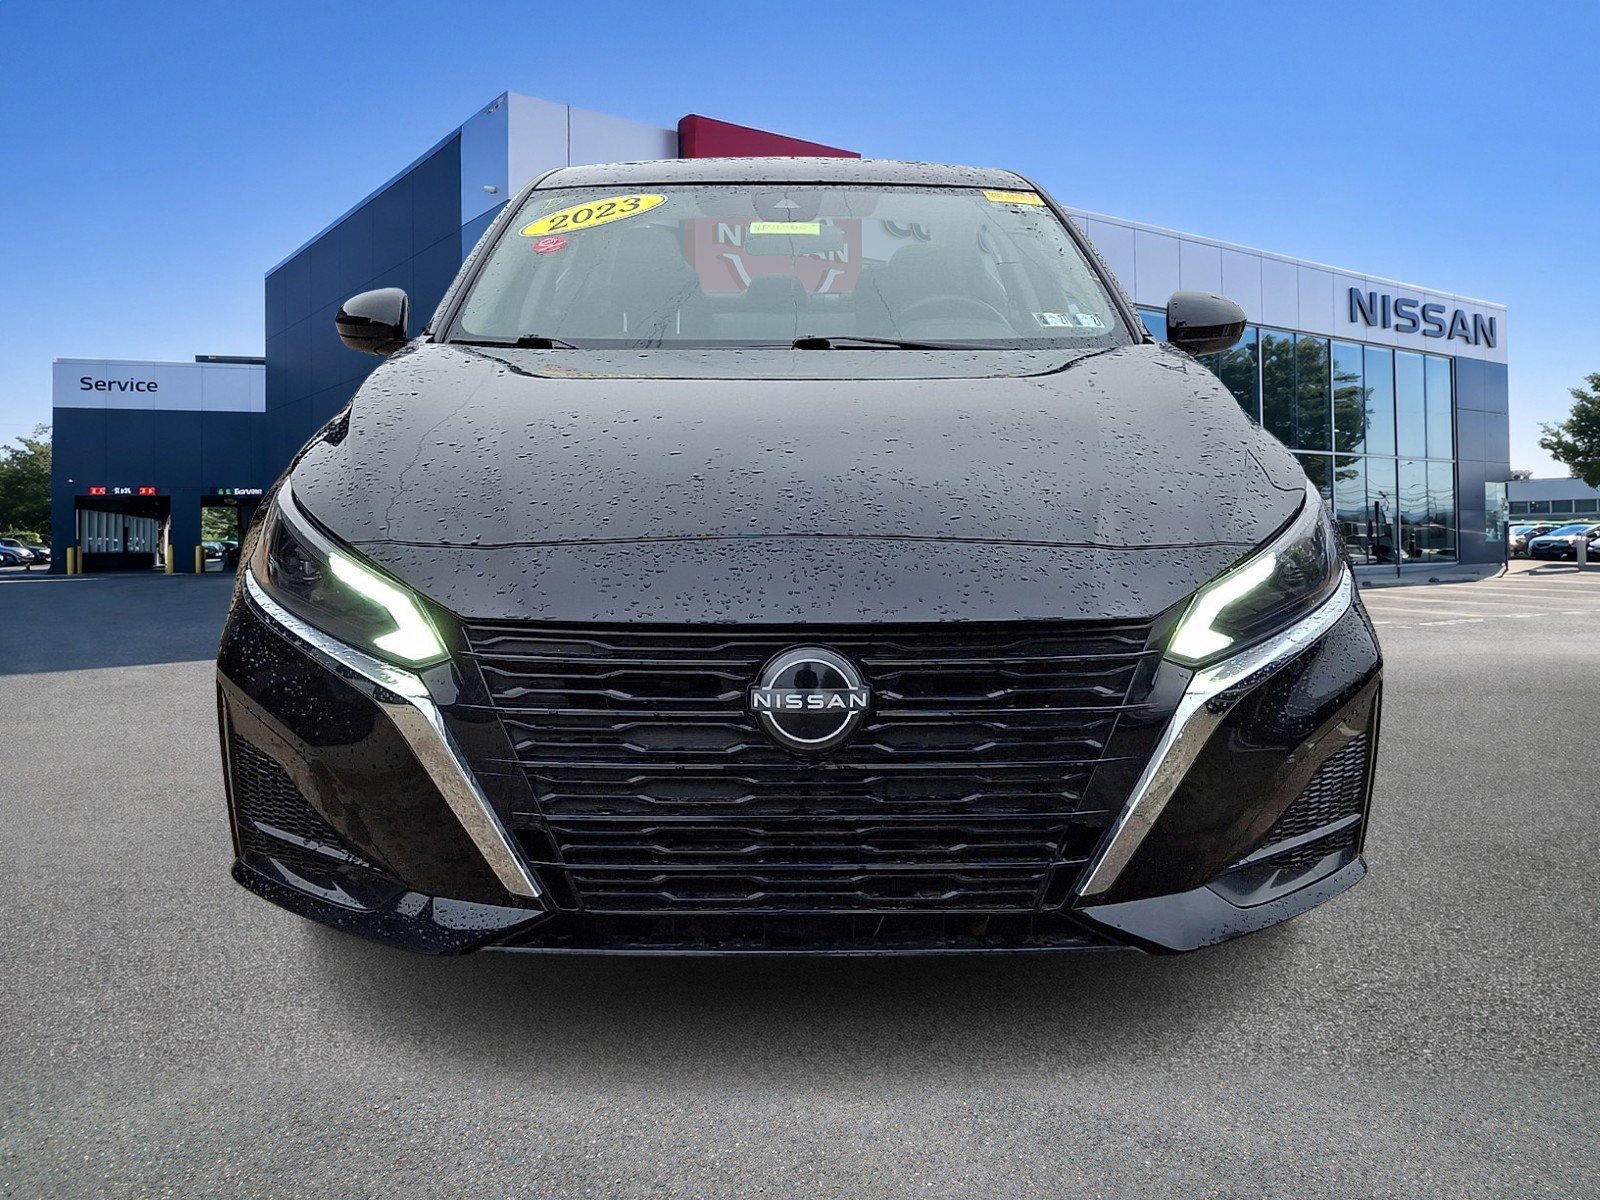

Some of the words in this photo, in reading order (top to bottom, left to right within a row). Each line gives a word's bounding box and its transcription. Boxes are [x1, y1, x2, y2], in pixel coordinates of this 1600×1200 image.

[548, 197, 641, 232] 2023
[1349, 287, 1497, 348] NISSAN
[80, 376, 158, 392] Service
[753, 692, 867, 709] NISSAN
